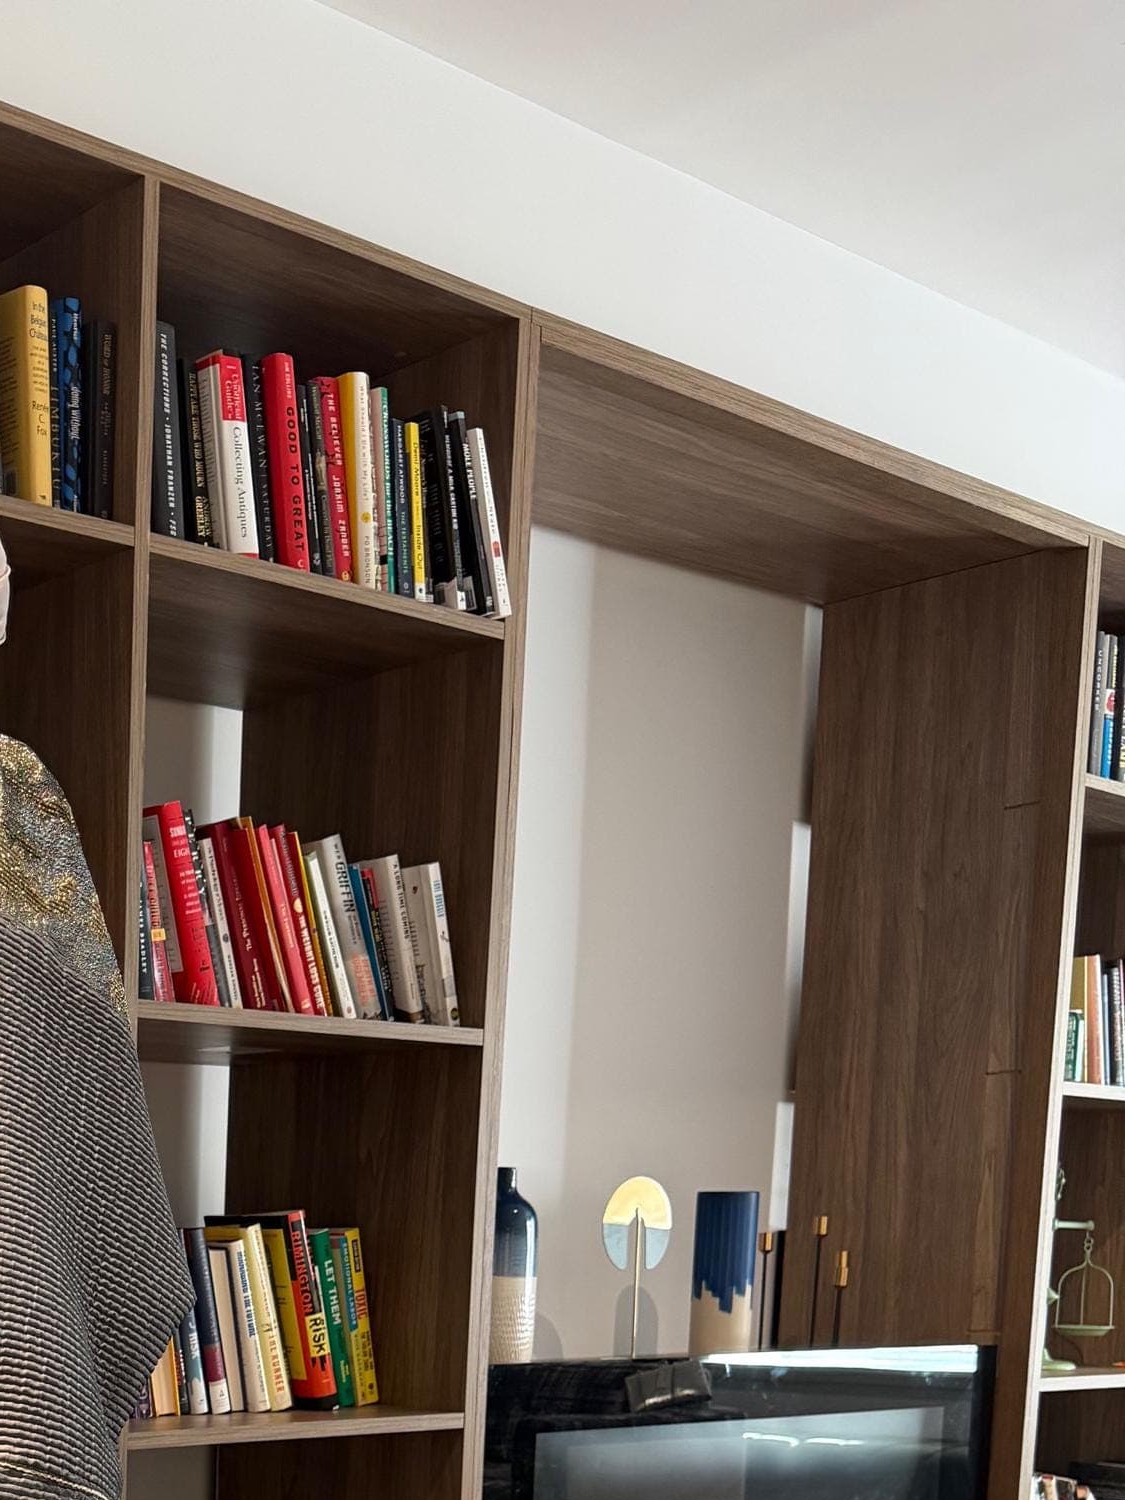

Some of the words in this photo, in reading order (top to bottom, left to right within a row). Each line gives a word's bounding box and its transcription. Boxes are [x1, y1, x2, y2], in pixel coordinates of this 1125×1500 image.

[68, 385, 81, 408] doing
[160, 353, 170, 414] CORRECTIONS
[251, 365, 261, 393] IAN
[326, 393, 335, 411] THE
[69, 409, 80, 440] without
[253, 400, 267, 469] McEWAN
[285, 406, 298, 454] GOOD
[329, 416, 342, 466] BELIEVER
[164, 423, 173, 466] JONATHAN
[230, 426, 245, 485] Collecting
[461, 442, 472, 466] MOLE
[166, 469, 175, 508] FRANZEN
[289, 463, 300, 486] TO
[332, 474, 343, 512] JOAKIM
[465, 468, 477, 499] PEOPLE
[194, 495, 204, 538] GREELEY
[234, 486, 249, 538] Antiques
[395, 425, 403, 468] MARGARET
[400, 527, 408, 574] TESTAMENTS
[291, 494, 304, 551] GREAT
[337, 519, 349, 557] ZANDER
[333, 860, 356, 914] GRIFFIN
[397, 892, 405, 909] TIME
[298, 927, 314, 961] WEIGHT
[399, 910, 410, 940] COMING
[307, 961, 320, 985] LOSS
[312, 984, 326, 1009] CURE
[289, 1230, 313, 1314] RIMINGTON
[323, 1259, 335, 1284] LET
[327, 1288, 342, 1325] THEM
[353, 1288, 367, 1320] TOXIC
[307, 1316, 329, 1355] RISK
[270, 1353, 286, 1393] RUNNER
